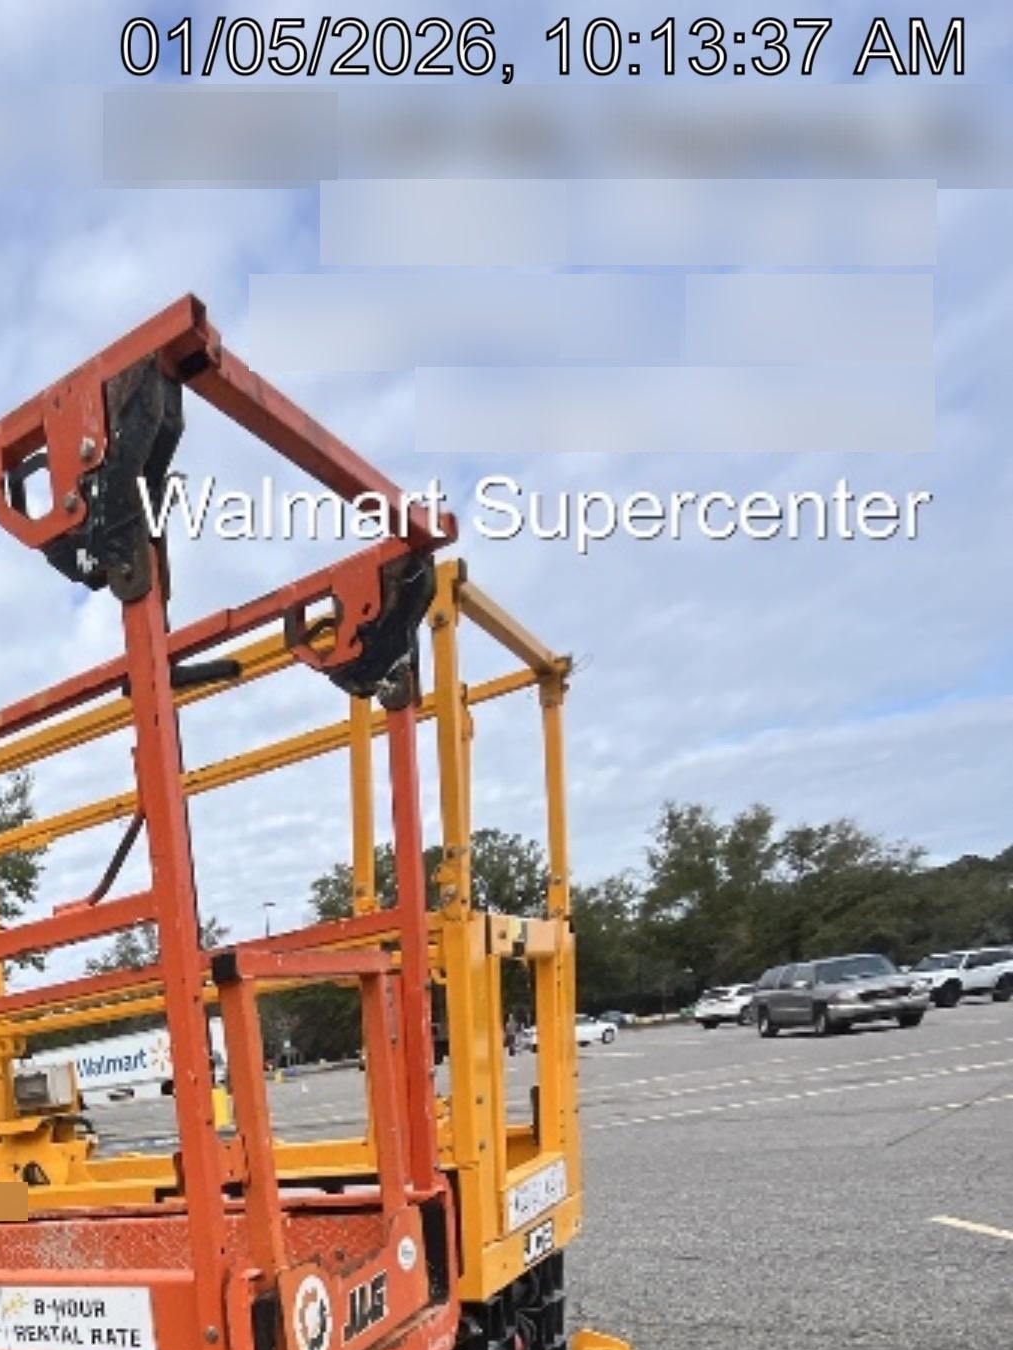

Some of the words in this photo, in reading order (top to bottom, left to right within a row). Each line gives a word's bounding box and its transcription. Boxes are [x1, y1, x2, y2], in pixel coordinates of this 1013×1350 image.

[77, 1049, 147, 1079] Walmart
[13, 1325, 85, 1345] RENTAL
[91, 1328, 142, 1348] RATE
